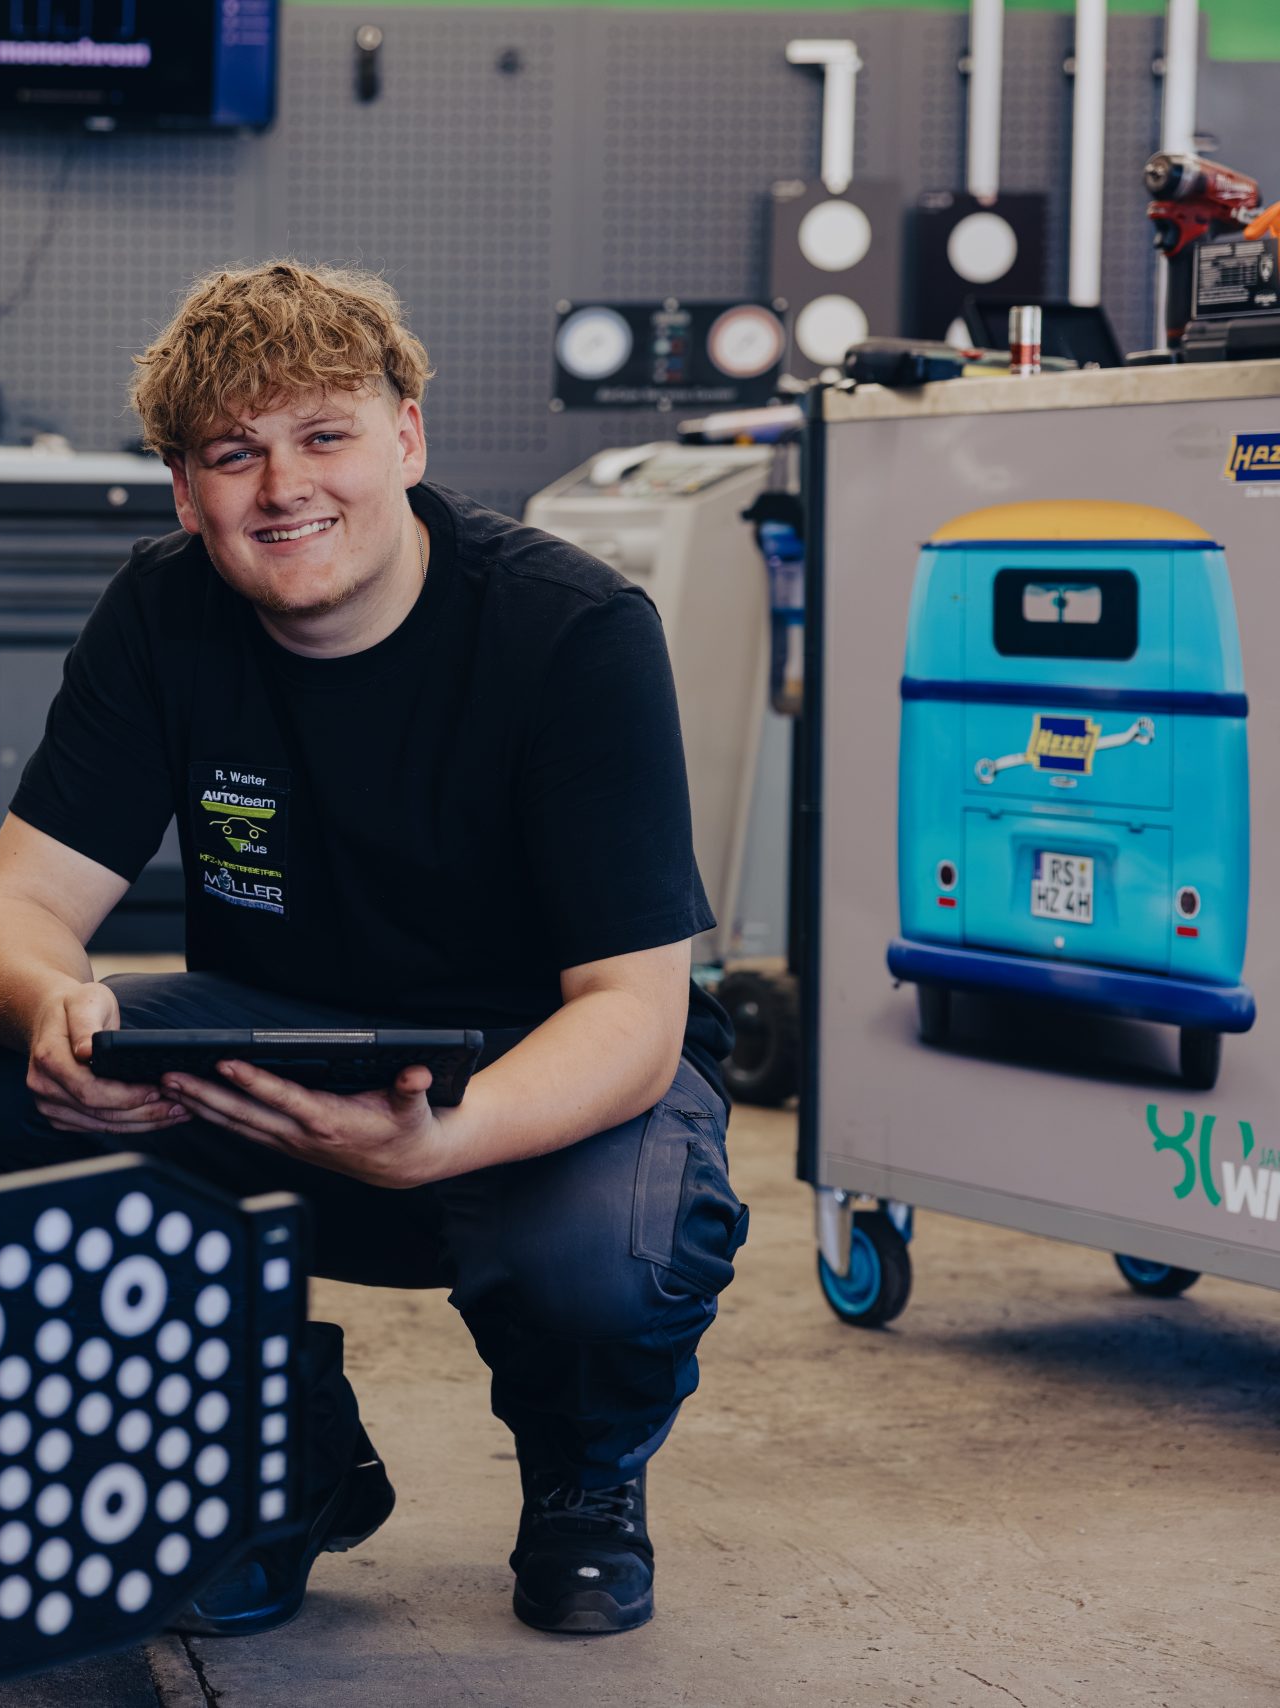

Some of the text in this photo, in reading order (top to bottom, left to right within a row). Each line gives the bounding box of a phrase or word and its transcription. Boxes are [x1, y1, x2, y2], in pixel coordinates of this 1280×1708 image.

[215, 769, 266, 786] R. Walter
[202, 790, 276, 809] AUTOteam
[240, 842, 268, 854] plus
[1051, 859, 1074, 886] RS
[204, 868, 282, 902] MLLER
